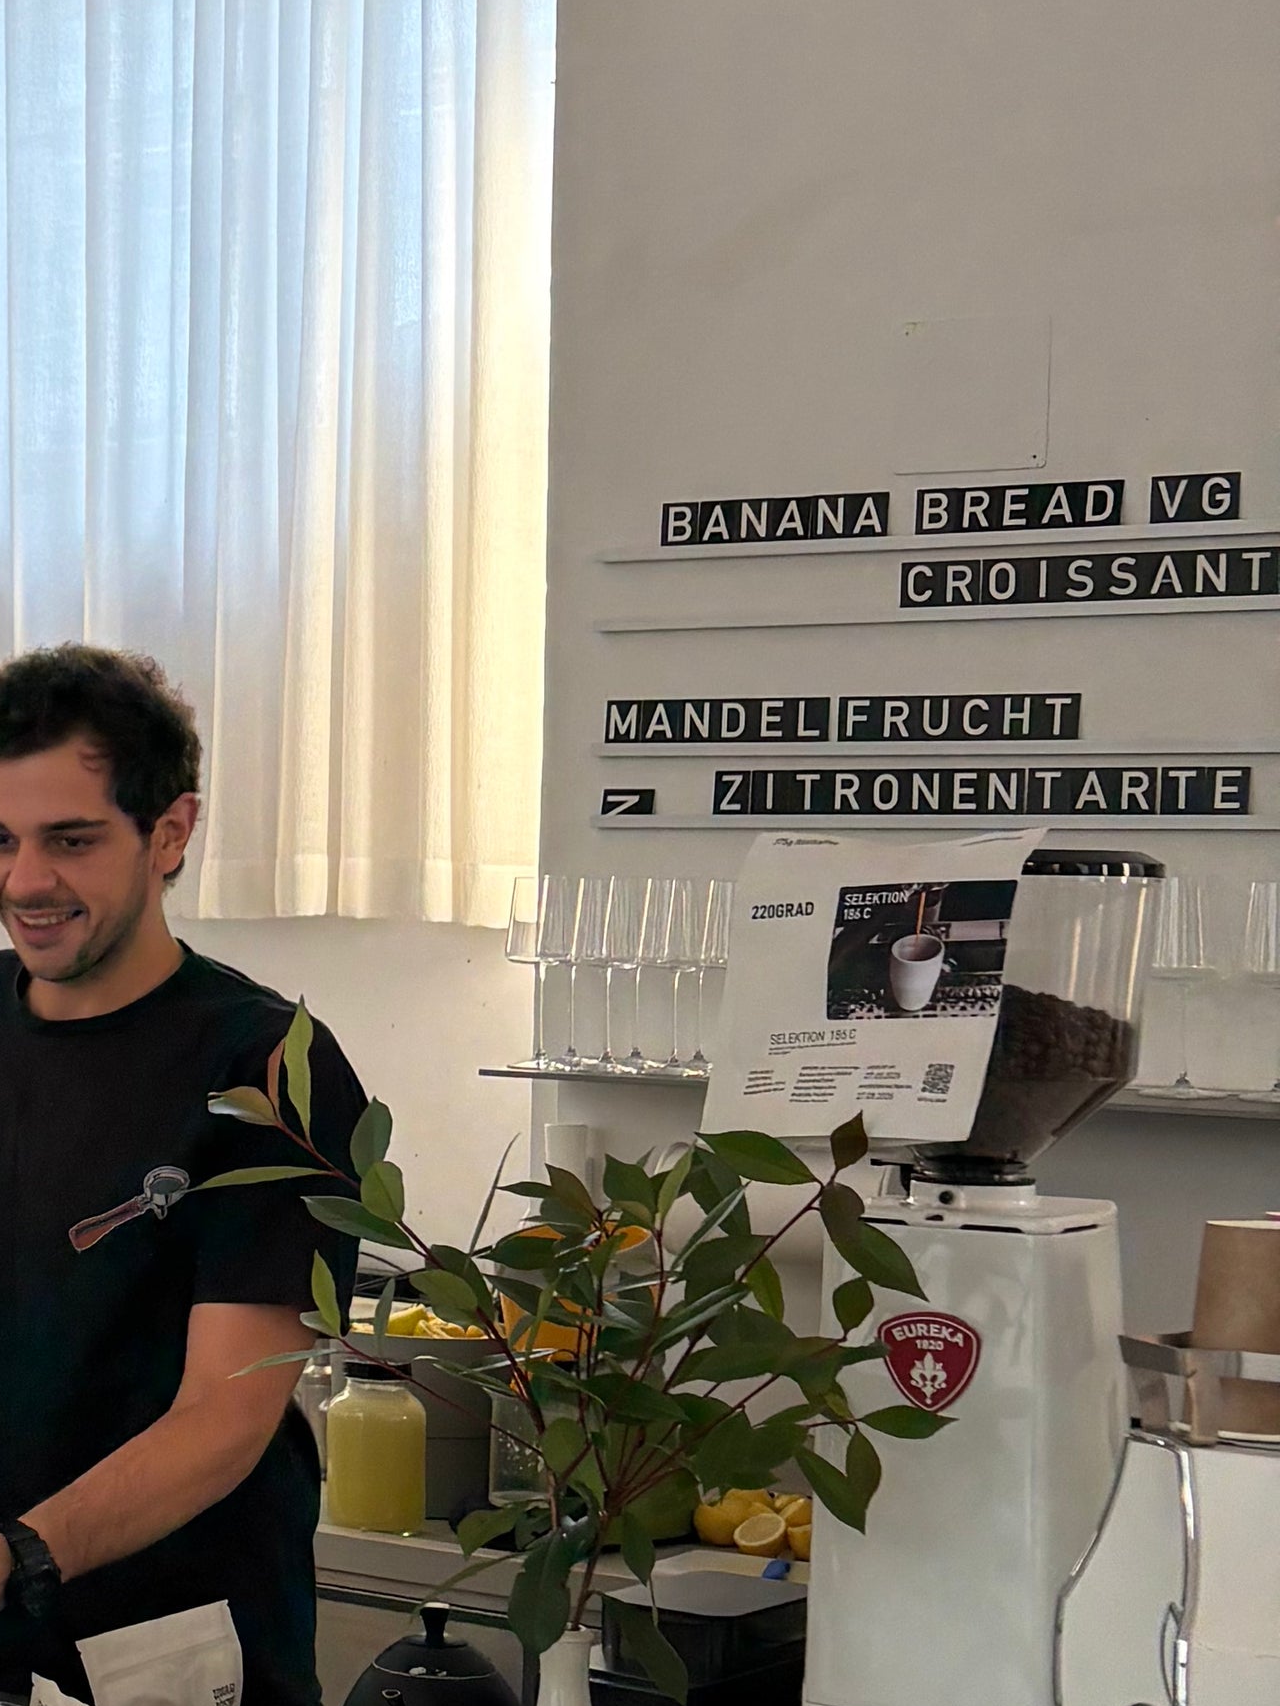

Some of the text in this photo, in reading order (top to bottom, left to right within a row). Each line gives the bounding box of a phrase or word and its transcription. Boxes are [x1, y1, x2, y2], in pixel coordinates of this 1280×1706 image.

[667, 476, 1231, 542] BANANA BREAD VG
[907, 551, 1272, 603] CROISSANT
[719, 770, 1242, 811] ZITRONENTARTE
[751, 901, 814, 919] 220GRAD
[844, 892, 909, 906] SELEKTION
[770, 1031, 825, 1045] SELEKTION
[891, 1323, 964, 1348] EUREKA
